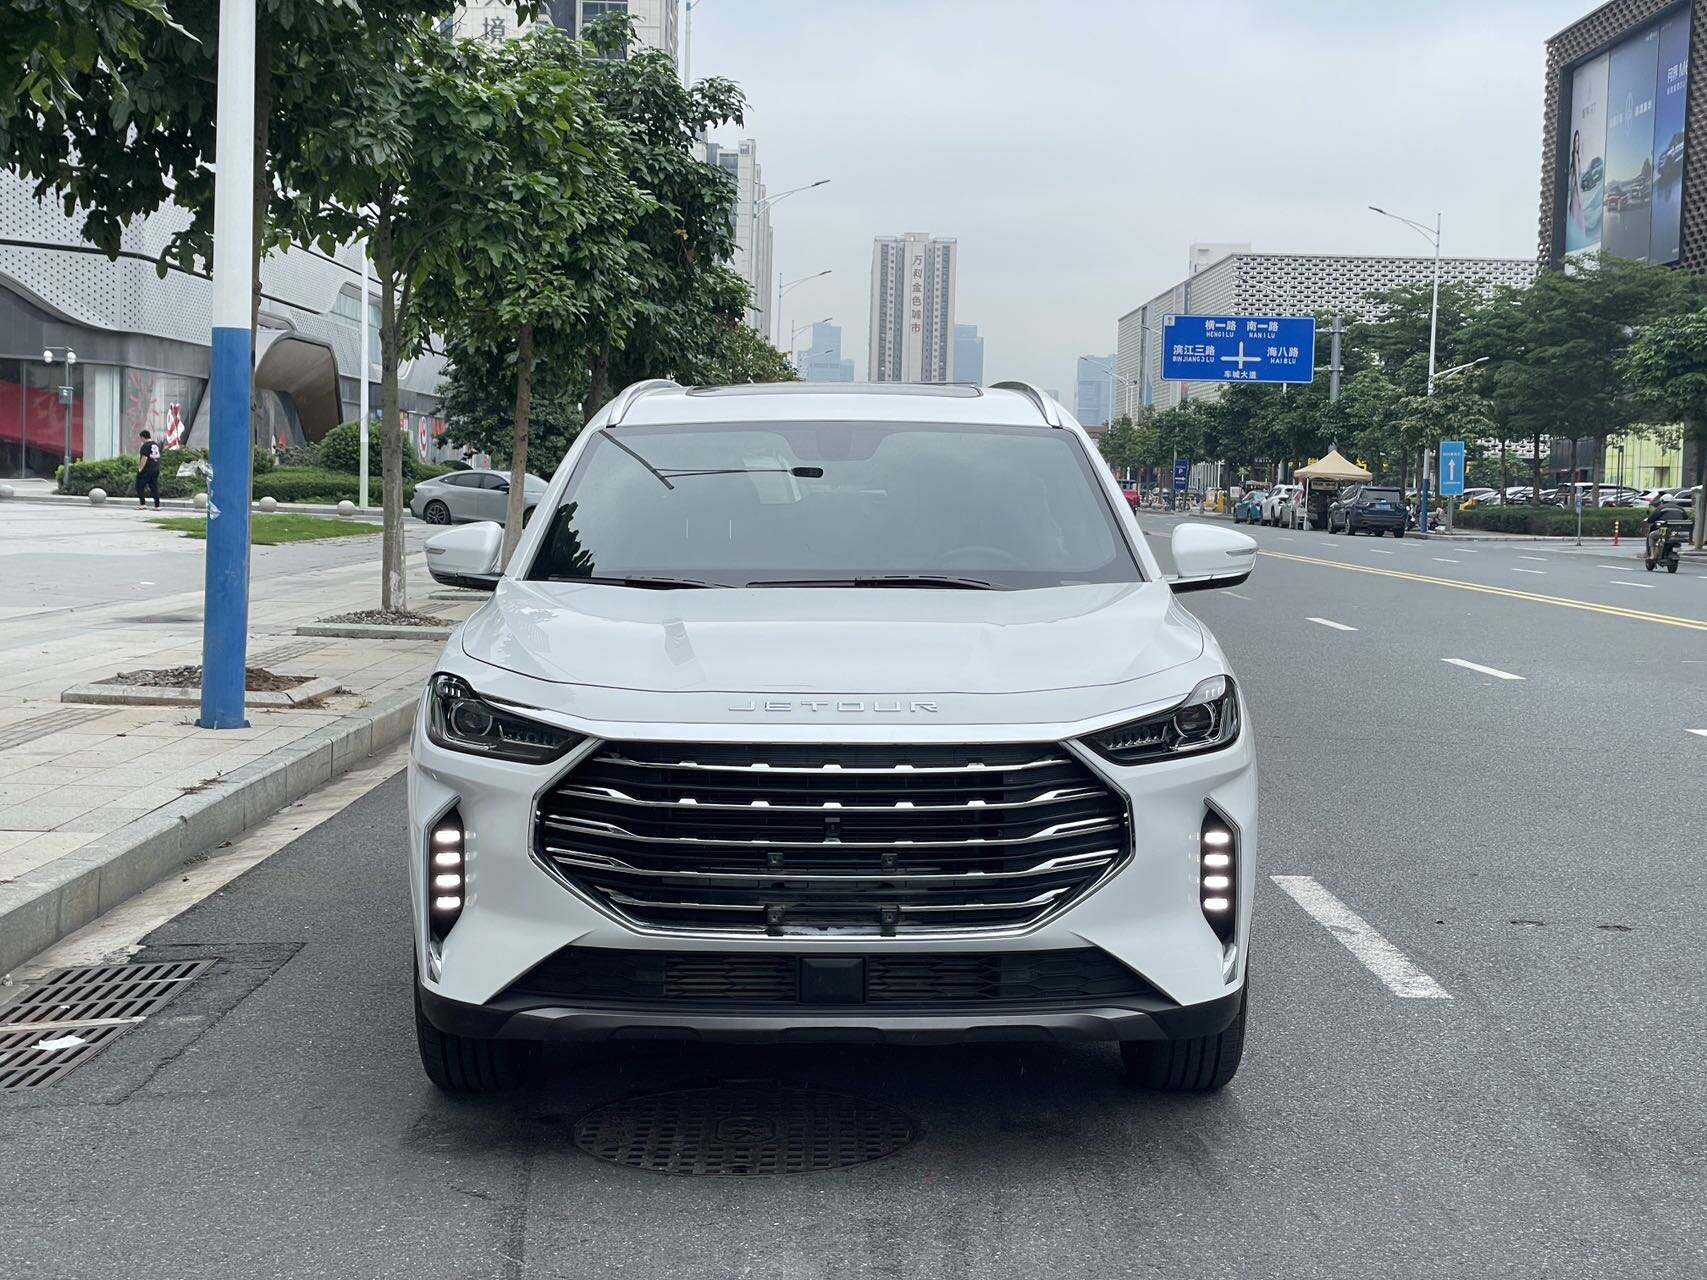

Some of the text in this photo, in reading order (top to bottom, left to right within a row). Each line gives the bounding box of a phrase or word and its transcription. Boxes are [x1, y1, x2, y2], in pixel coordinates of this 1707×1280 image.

[1205, 320, 1237, 331] 横一路
[1247, 320, 1279, 331] 南一路
[1173, 344, 1215, 356] 滨江三路
[1267, 346, 1299, 357] 海八路
[1223, 370, 1257, 380] 车城大道
[728, 701, 938, 713] JETOUR
